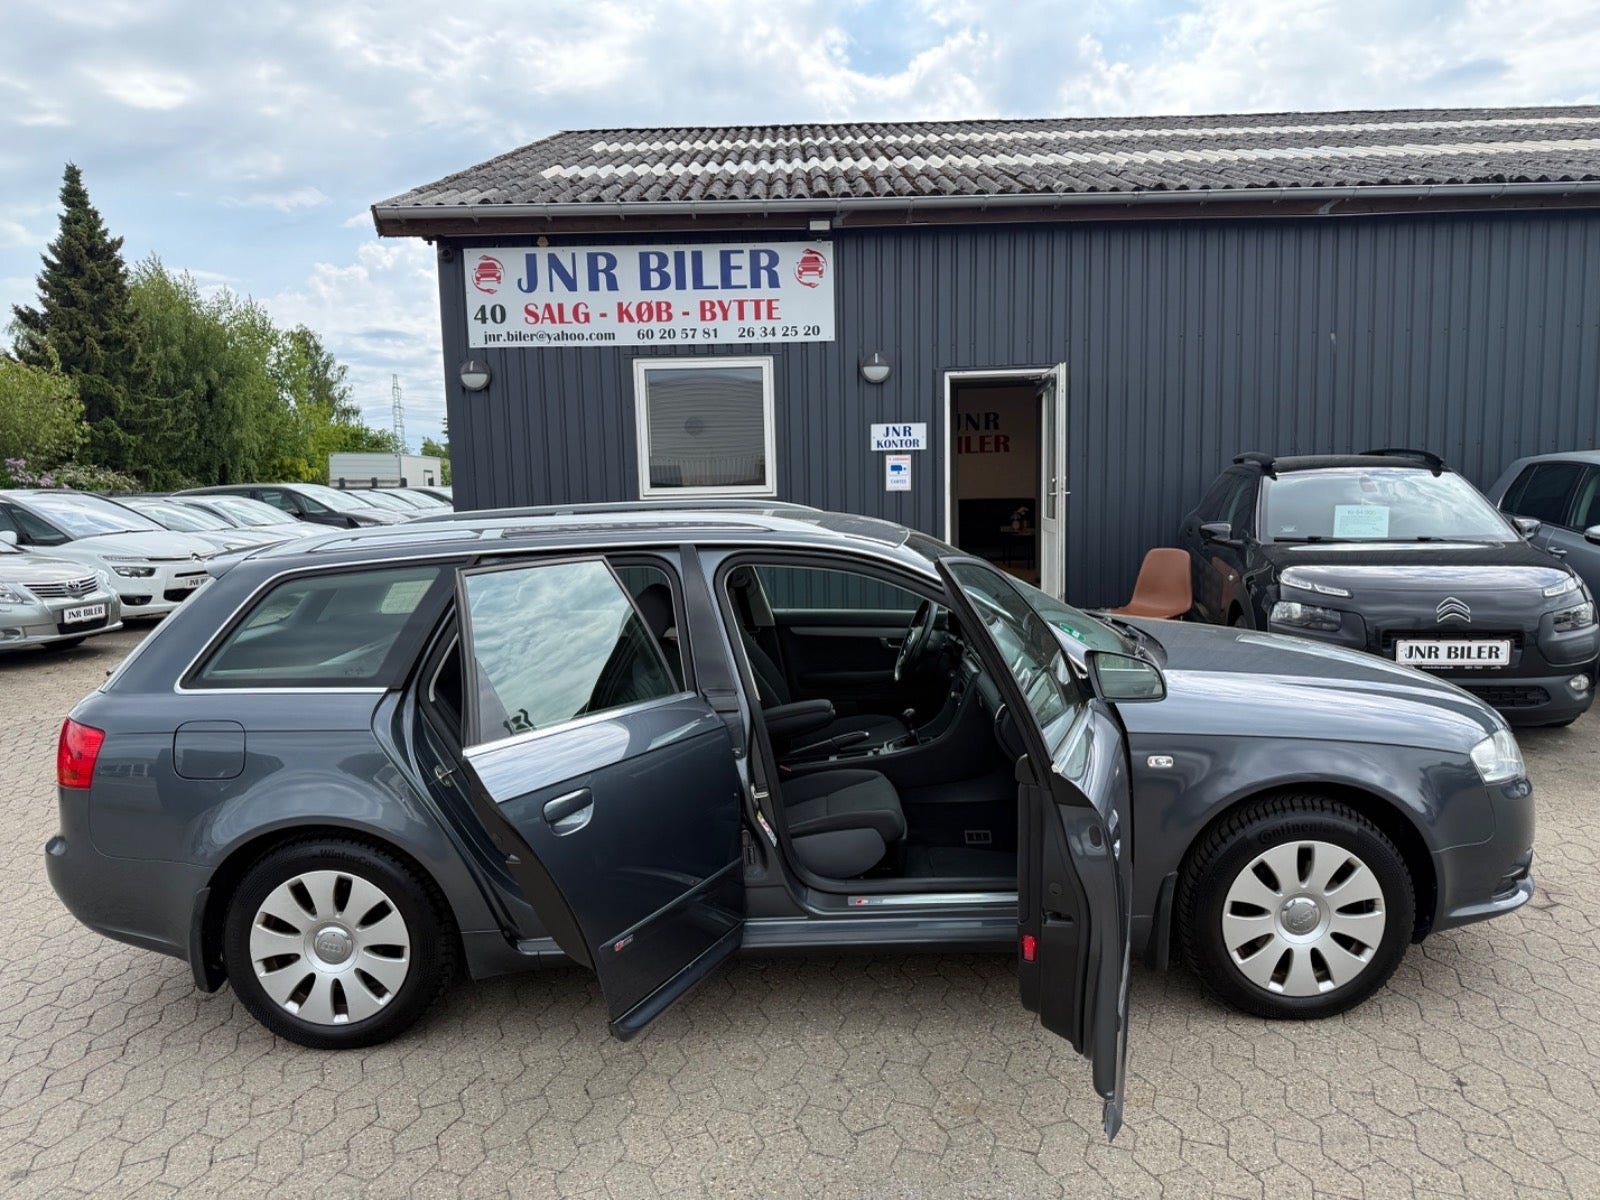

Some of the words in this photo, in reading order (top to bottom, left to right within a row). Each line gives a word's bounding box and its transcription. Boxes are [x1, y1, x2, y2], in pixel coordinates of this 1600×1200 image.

[517, 252, 620, 294] JNR
[638, 249, 781, 291] BILER
[473, 304, 507, 325] 40
[524, 302, 590, 325] SALG
[617, 300, 673, 325] KØB
[699, 298, 782, 322] BYTTE
[483, 330, 616, 346] jnr.biler@yahoo.com
[636, 328, 655, 340] 60
[658, 328, 677, 340] 20
[680, 328, 698, 339] 57
[702, 327, 719, 339] 81
[737, 326, 755, 338] 26
[759, 326, 777, 338] 34
[781, 325, 799, 337] 25
[803, 325, 821, 337] 20
[883, 425, 913, 438] JNR
[876, 438, 920, 449] KONTOR
[957, 434, 1010, 454] ILER
[68, 609, 82, 620] JNR
[83, 606, 103, 617] BILER
[1404, 645, 1440, 660] JNR
[1446, 645, 1500, 660] BILER
